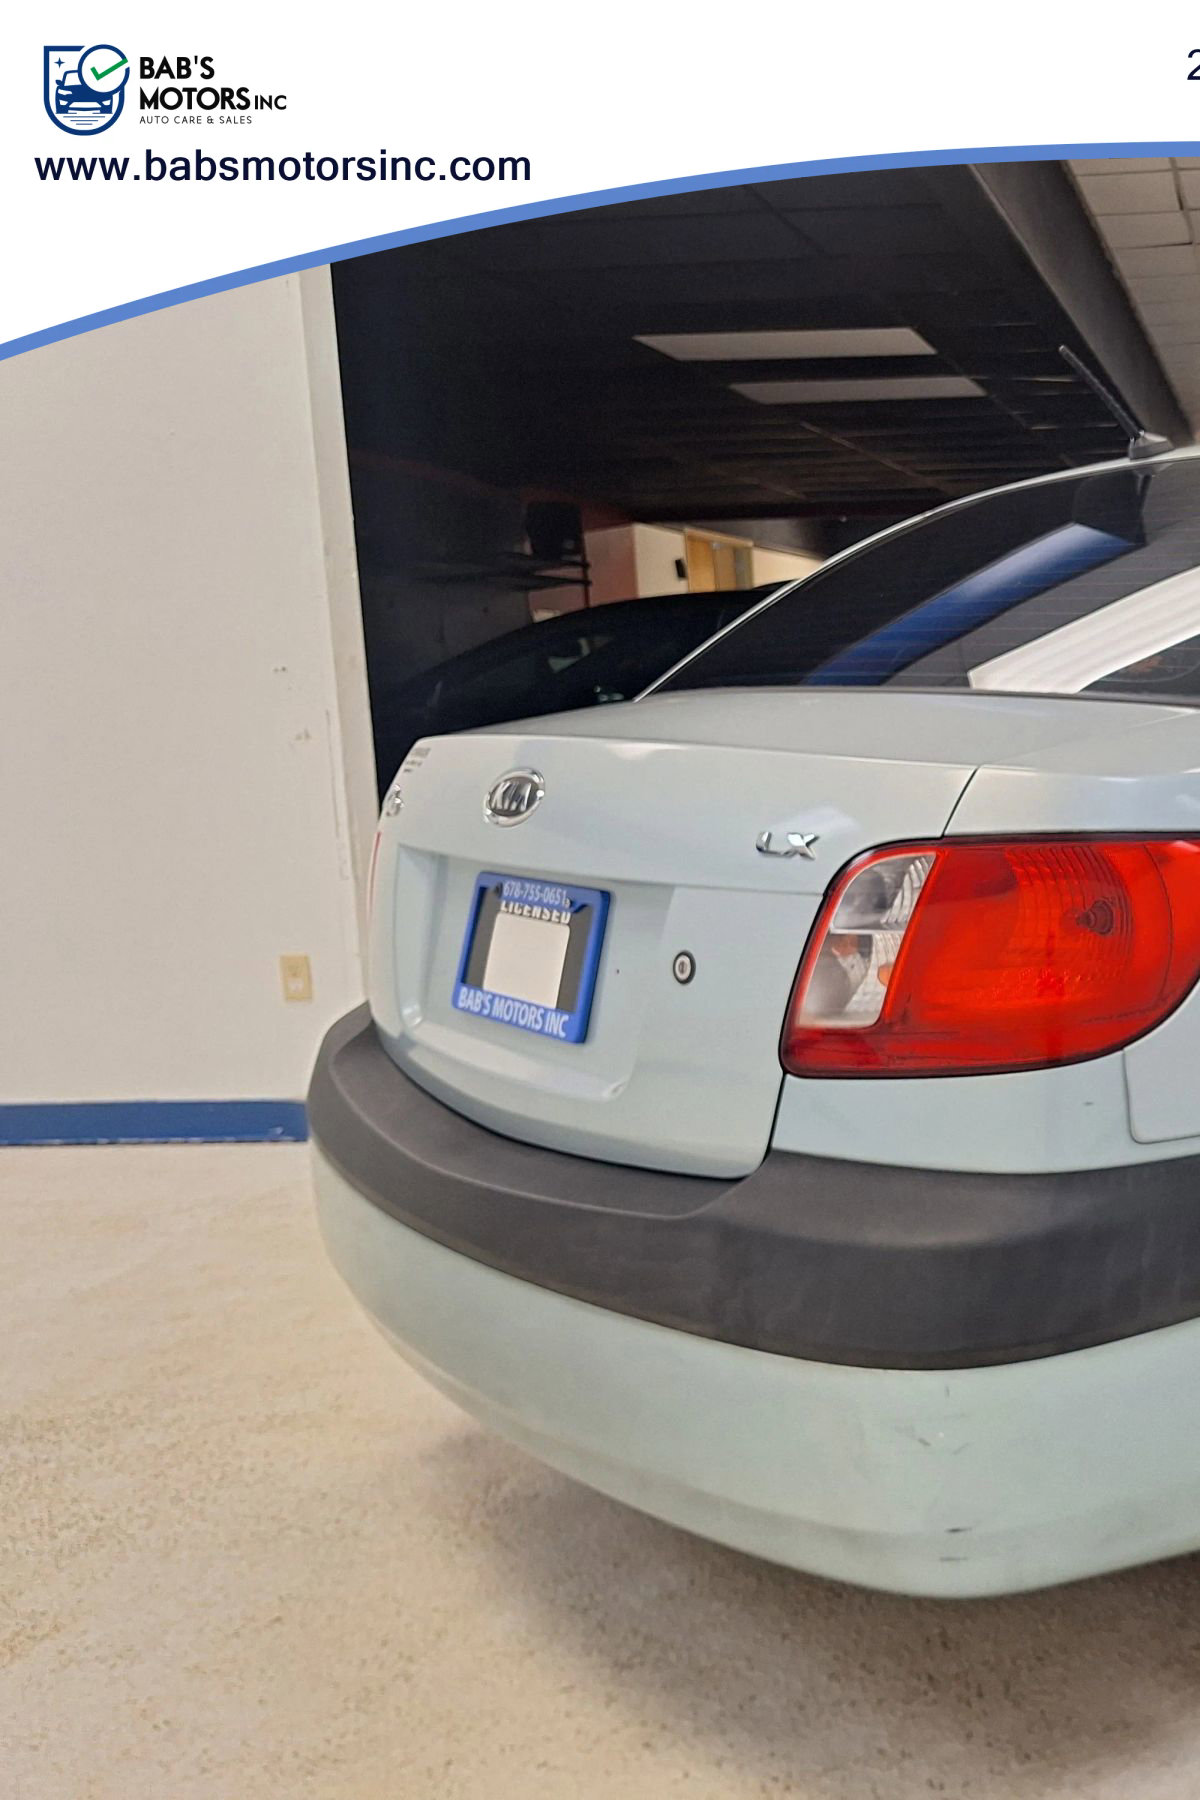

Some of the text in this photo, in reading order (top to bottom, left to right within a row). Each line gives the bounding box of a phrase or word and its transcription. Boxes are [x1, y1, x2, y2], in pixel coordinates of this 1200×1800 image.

[755, 831, 820, 861] LX
[502, 880, 567, 906] 678-755-0651
[500, 900, 571, 924] LICENSED
[458, 986, 569, 1038] BAB'S MOTORS INC
